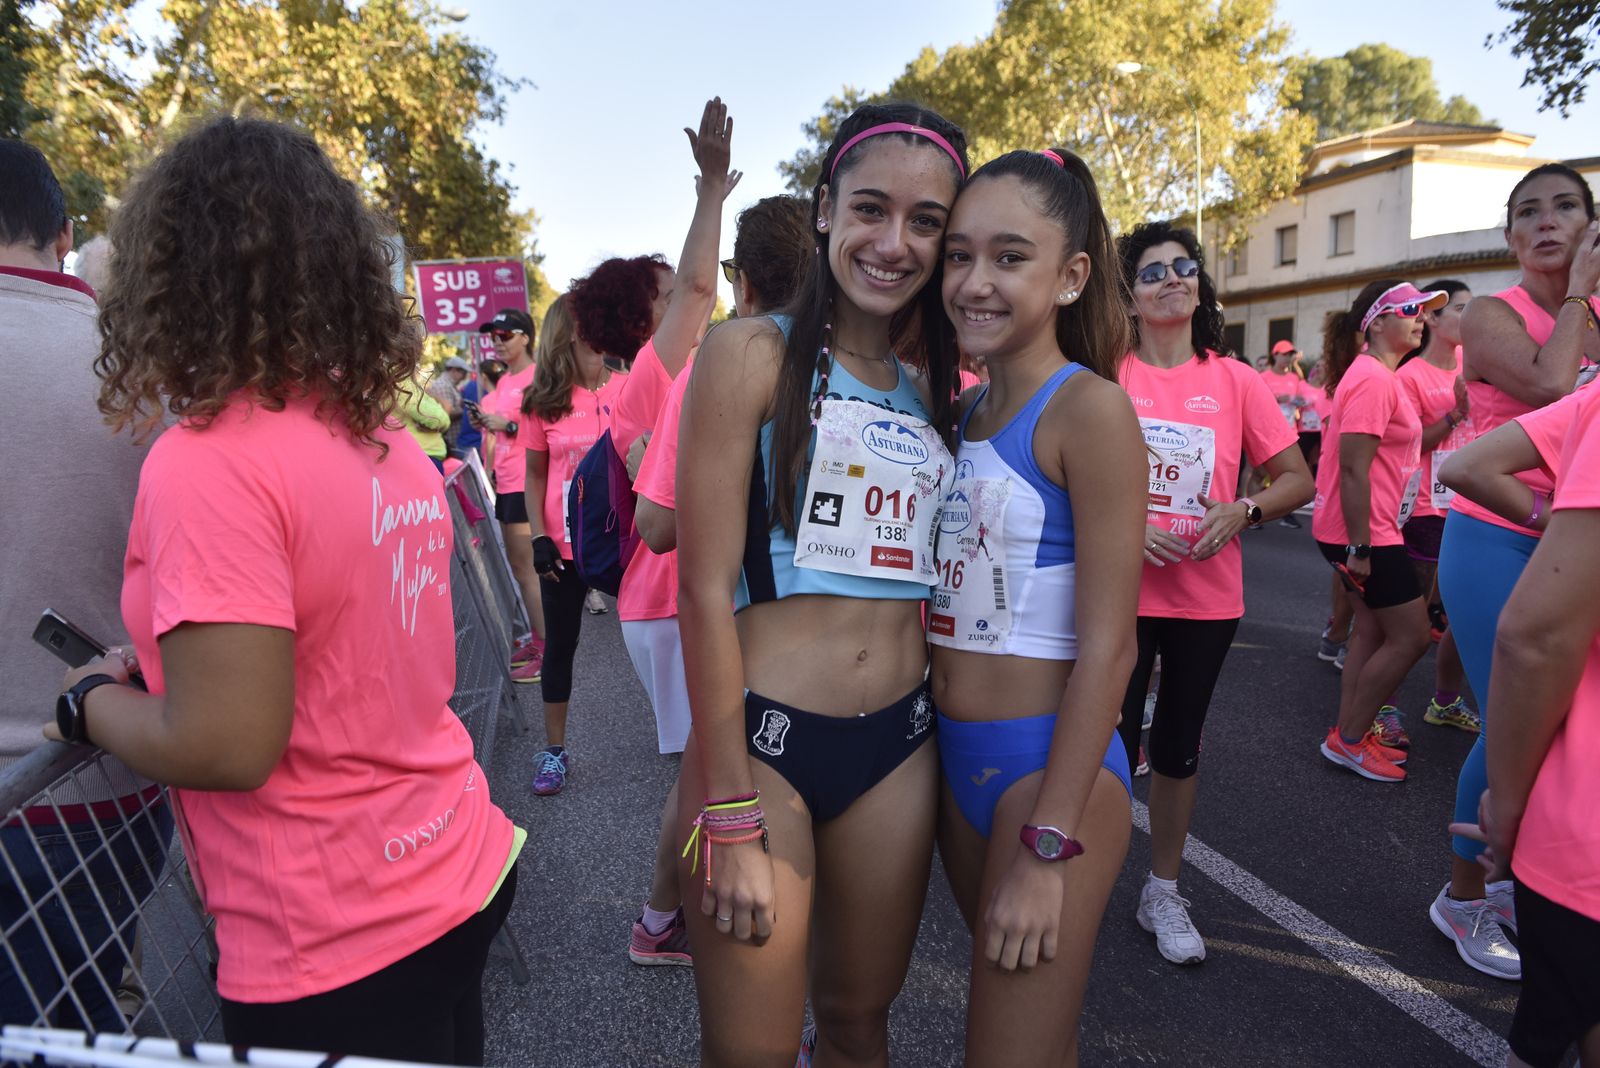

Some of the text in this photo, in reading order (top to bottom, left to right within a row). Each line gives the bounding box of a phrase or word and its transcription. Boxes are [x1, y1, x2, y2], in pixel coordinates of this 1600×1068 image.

[432, 269, 481, 292] SUB
[435, 296, 487, 326] 35'
[868, 430, 925, 459] ASTURIANA
[1152, 463, 1180, 482] 16
[372, 477, 445, 546] Carrera
[864, 485, 917, 523] 016
[875, 525, 907, 542] 1383
[807, 542, 855, 559] OYSHO
[384, 809, 455, 862] OYSHO
